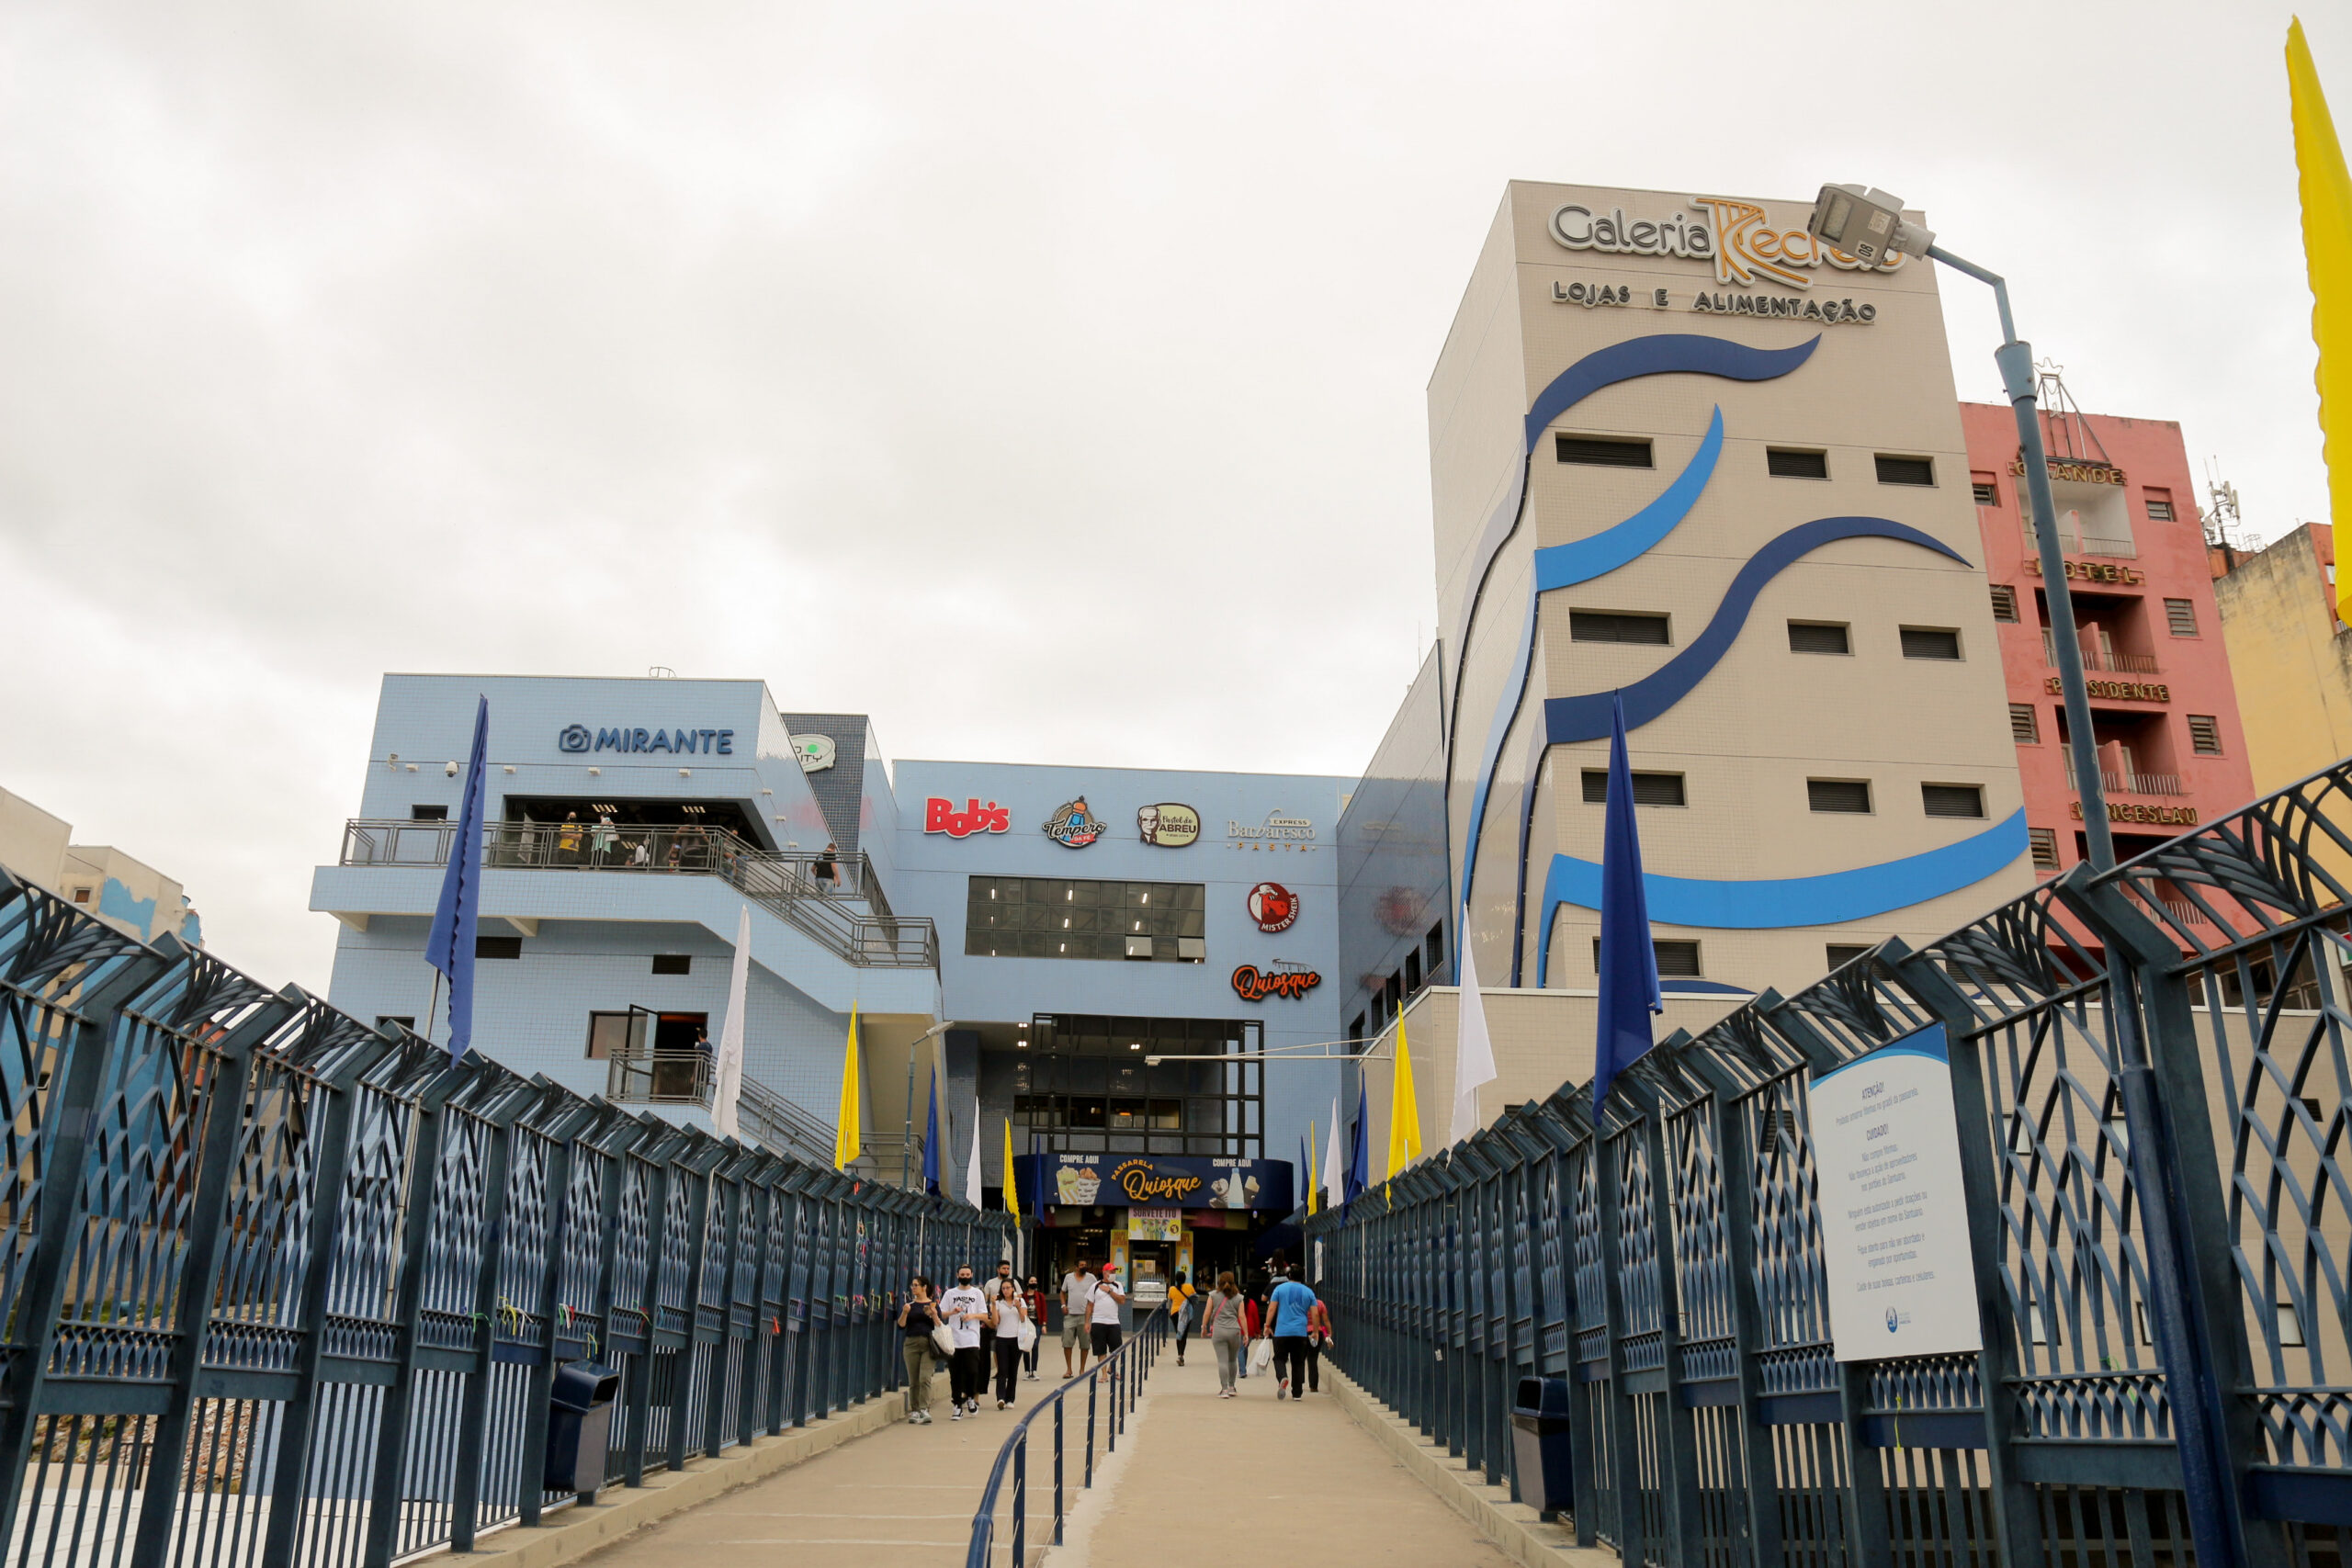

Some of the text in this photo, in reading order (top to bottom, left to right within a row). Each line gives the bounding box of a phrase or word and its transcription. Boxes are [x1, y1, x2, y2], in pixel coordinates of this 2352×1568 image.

[1555, 205, 1711, 253] Galeria
[1553, 281, 1877, 321] LOJAS E ALIMENTAÇÃO
[2015, 462, 2126, 485] GANDE
[2052, 678, 2170, 703] PSIDENTE
[594, 728, 734, 754] MIRANTE
[925, 797, 1010, 837] Bob's
[1162, 815, 1182, 824] Pastel
[1227, 808, 1316, 840] Barbaresco
[2076, 802, 2198, 825] NCESLAU
[1042, 818, 1106, 840] Tempero
[1159, 823, 1196, 833] ABREU
[1237, 841, 1307, 852] PASTA
[1261, 896, 1298, 931] MISTER SHEIK
[1233, 965, 1320, 1000] Quiosque
[1866, 1123, 1889, 1141] CUIDADO!
[1059, 1154, 1099, 1164] COMPRE AQUI
[1111, 1158, 1154, 1181] PASSARELA
[1213, 1158, 1252, 1168] COMPRE AQUI
[1124, 1168, 1202, 1201] Quiosque
[1133, 1207, 1176, 1218] SORVETE ITU
